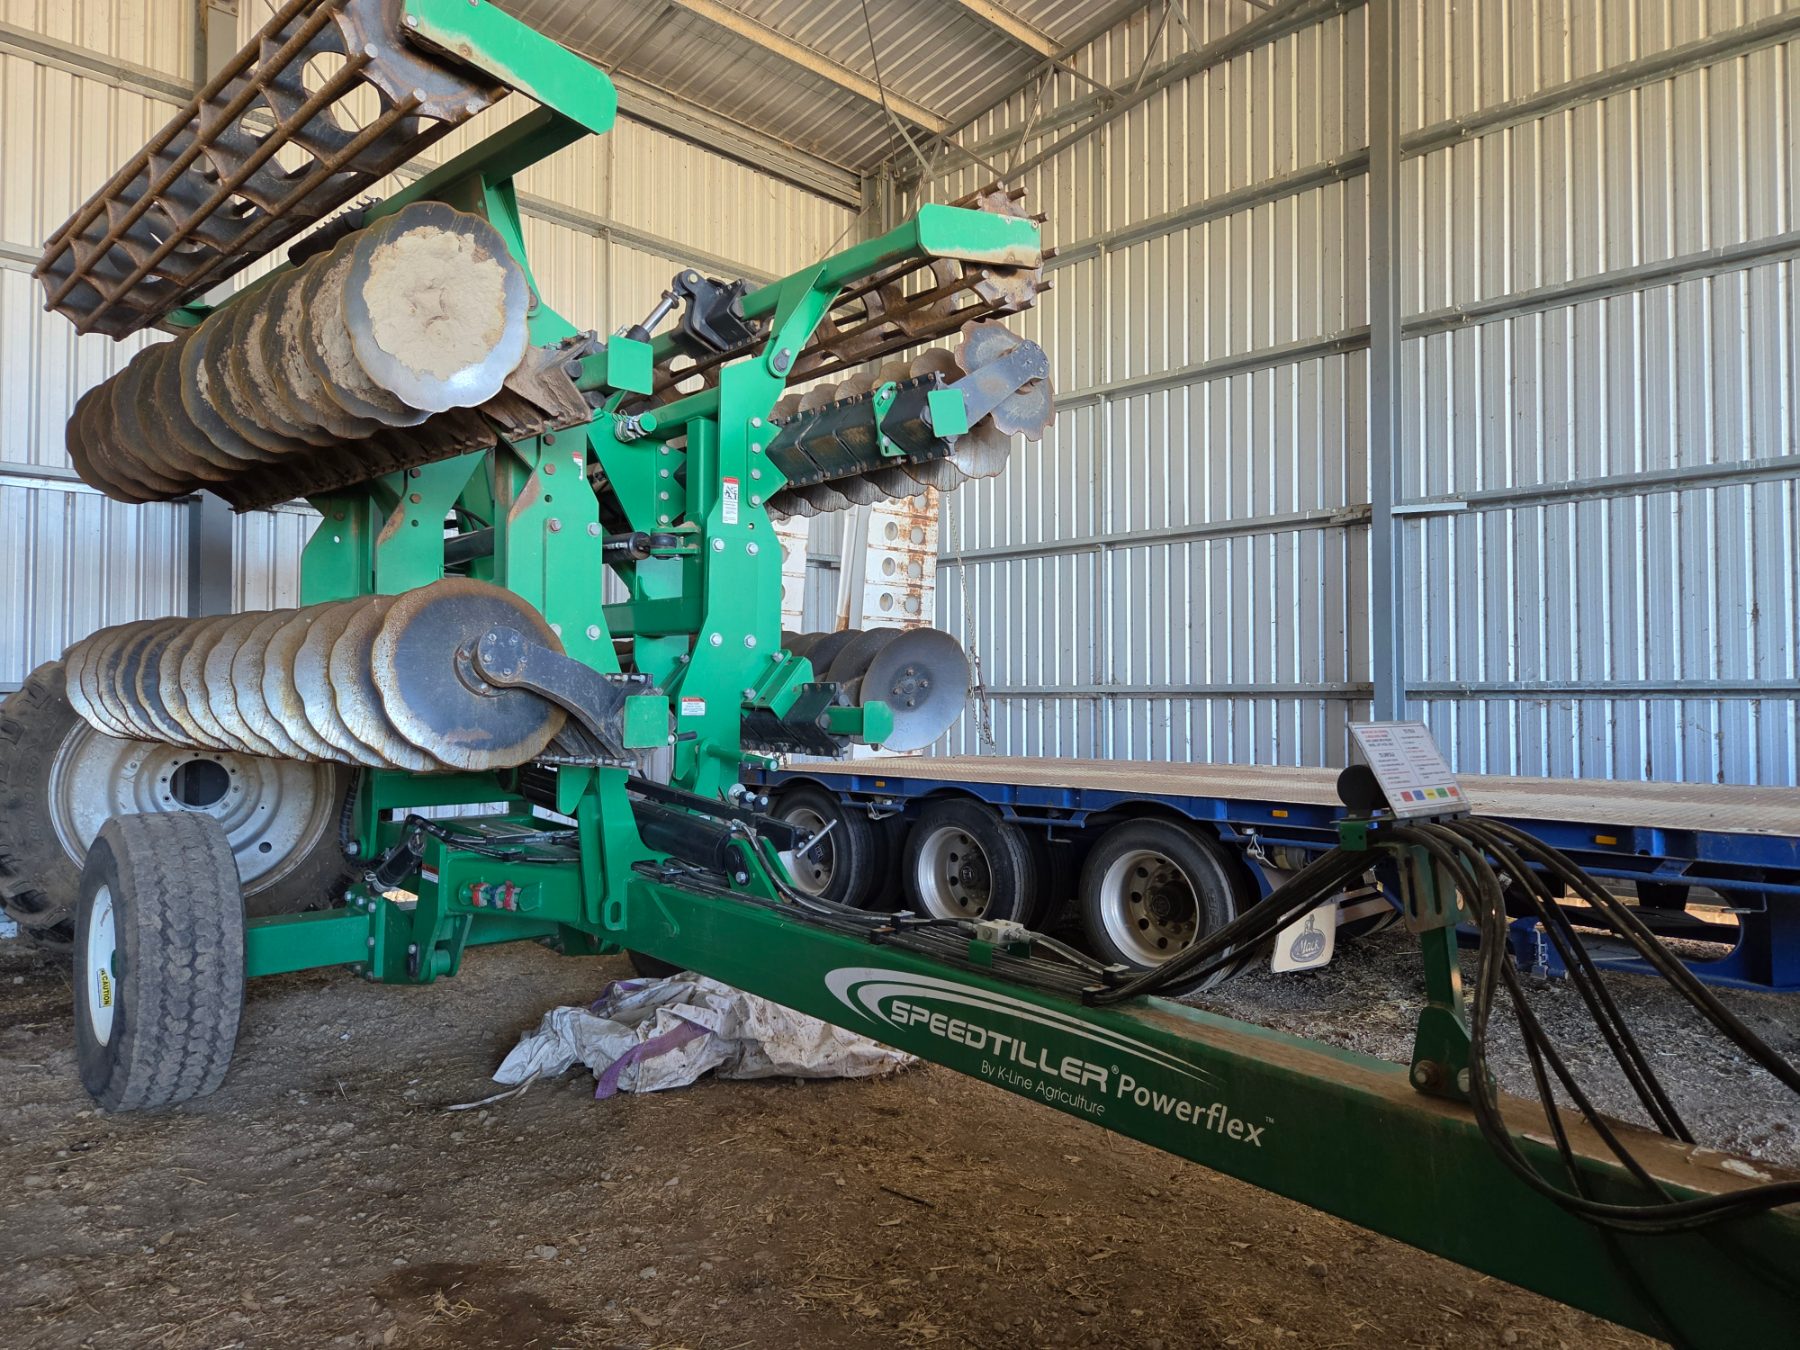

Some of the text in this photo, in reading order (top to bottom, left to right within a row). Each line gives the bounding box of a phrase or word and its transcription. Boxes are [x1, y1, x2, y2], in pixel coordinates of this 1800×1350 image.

[1297, 939, 1320, 955] Mack
[981, 1060, 1105, 1116] By K-Line Agriculture
